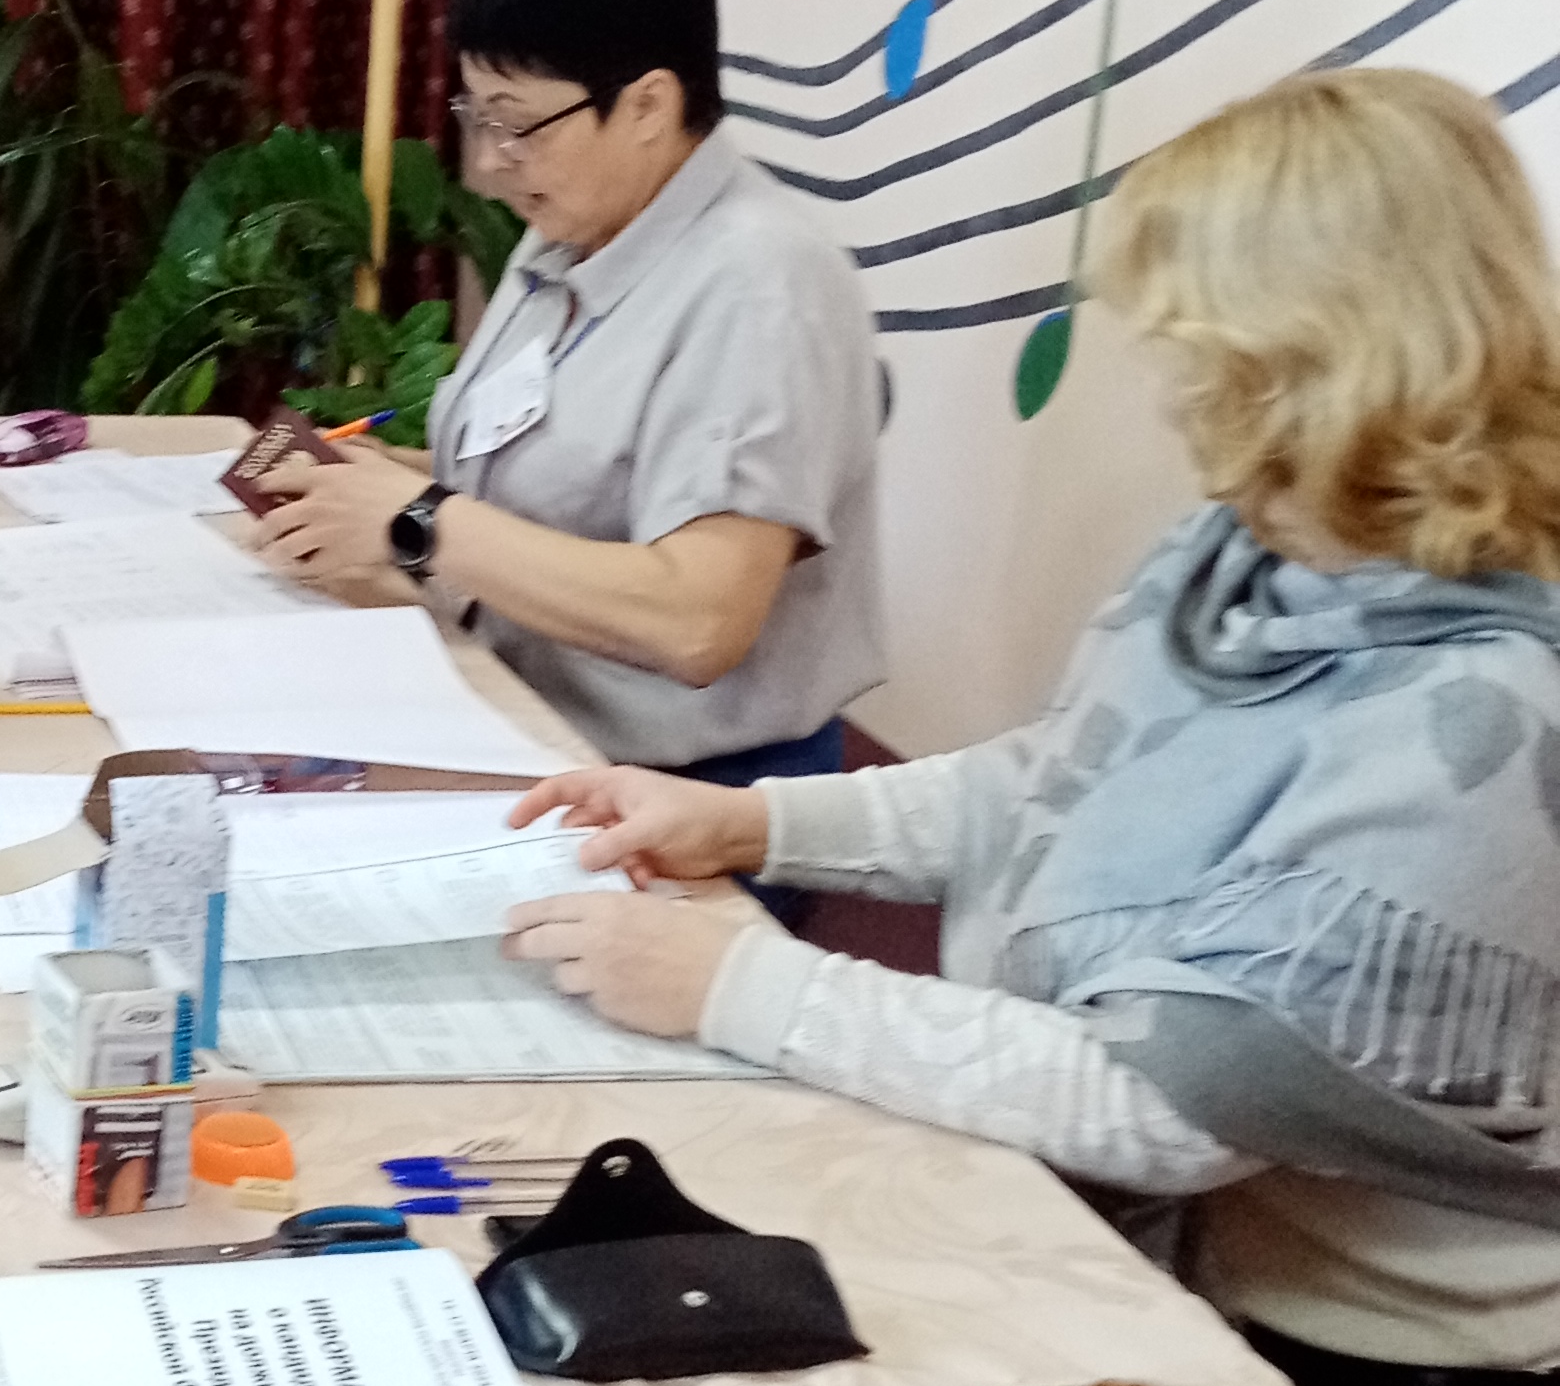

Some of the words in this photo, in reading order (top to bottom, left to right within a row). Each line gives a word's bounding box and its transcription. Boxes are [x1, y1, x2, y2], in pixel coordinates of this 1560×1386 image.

[226, 1307, 255, 1331] на
[265, 1306, 291, 1320] о
[135, 1276, 195, 1376] Российской
